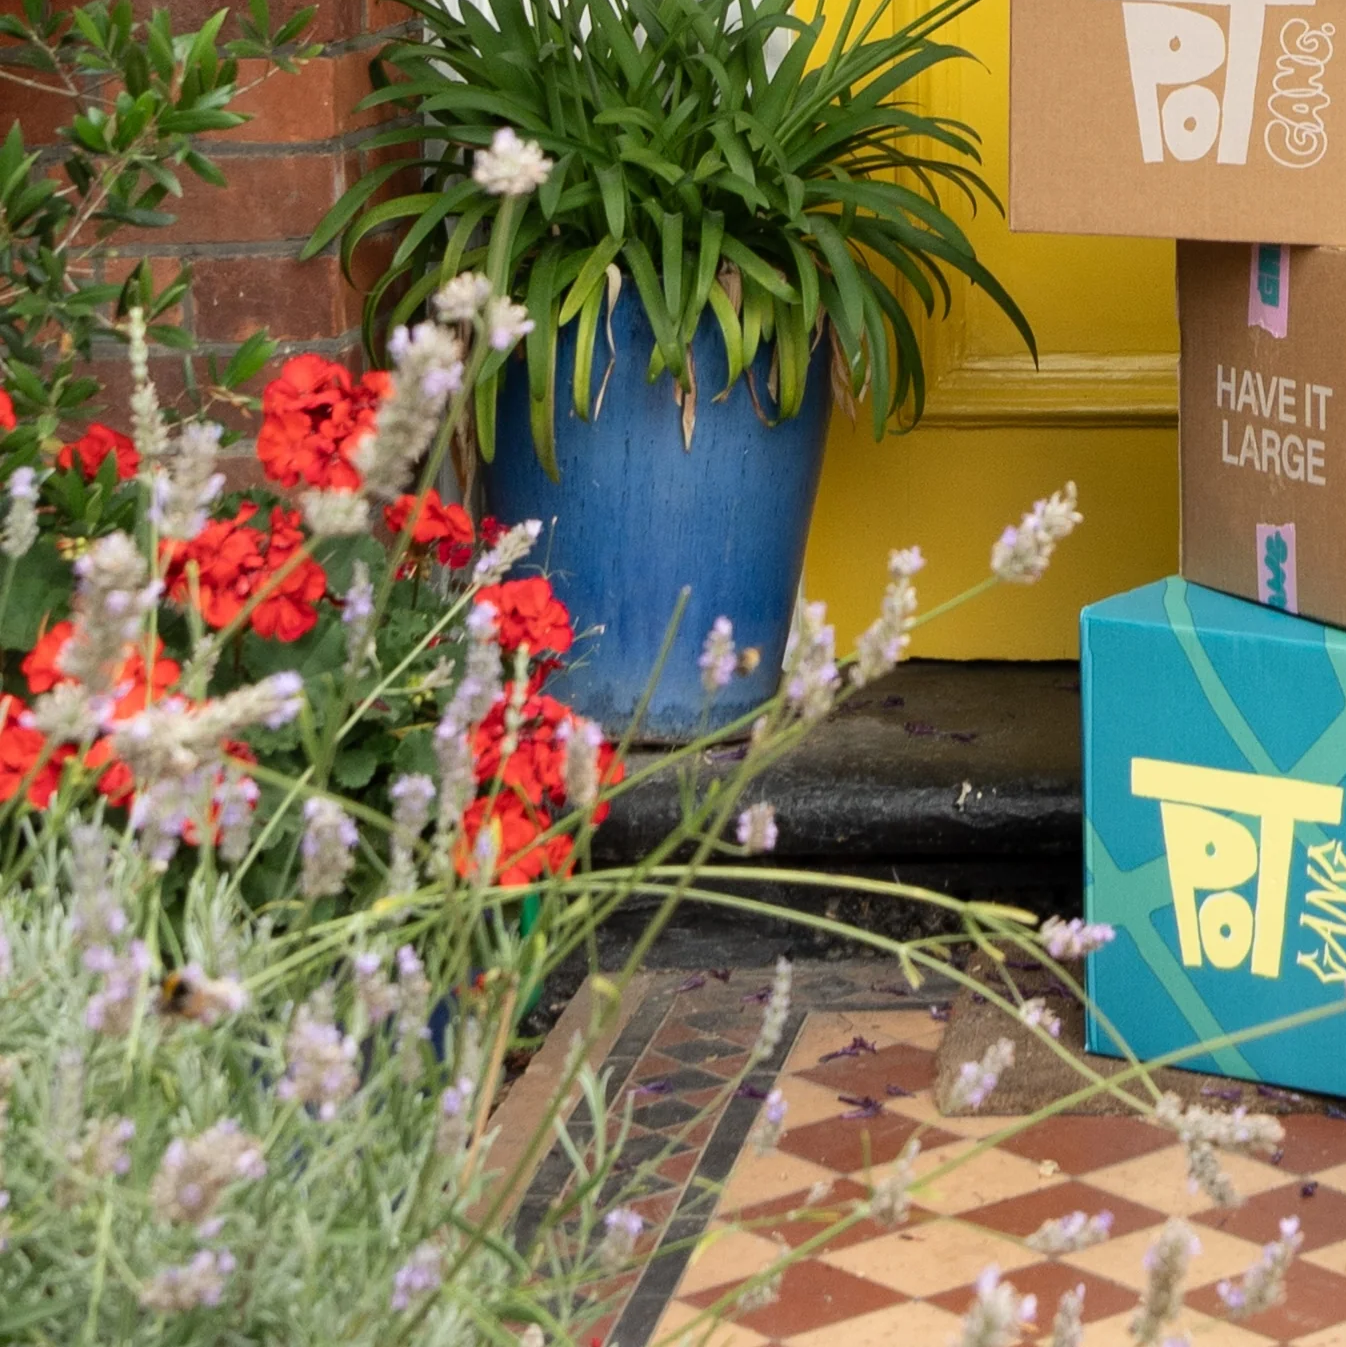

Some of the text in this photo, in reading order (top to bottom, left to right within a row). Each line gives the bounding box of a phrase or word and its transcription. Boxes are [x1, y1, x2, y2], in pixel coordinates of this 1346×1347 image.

[1216, 364, 1333, 431] HAVE IT
[1221, 419, 1326, 486] LARGE
